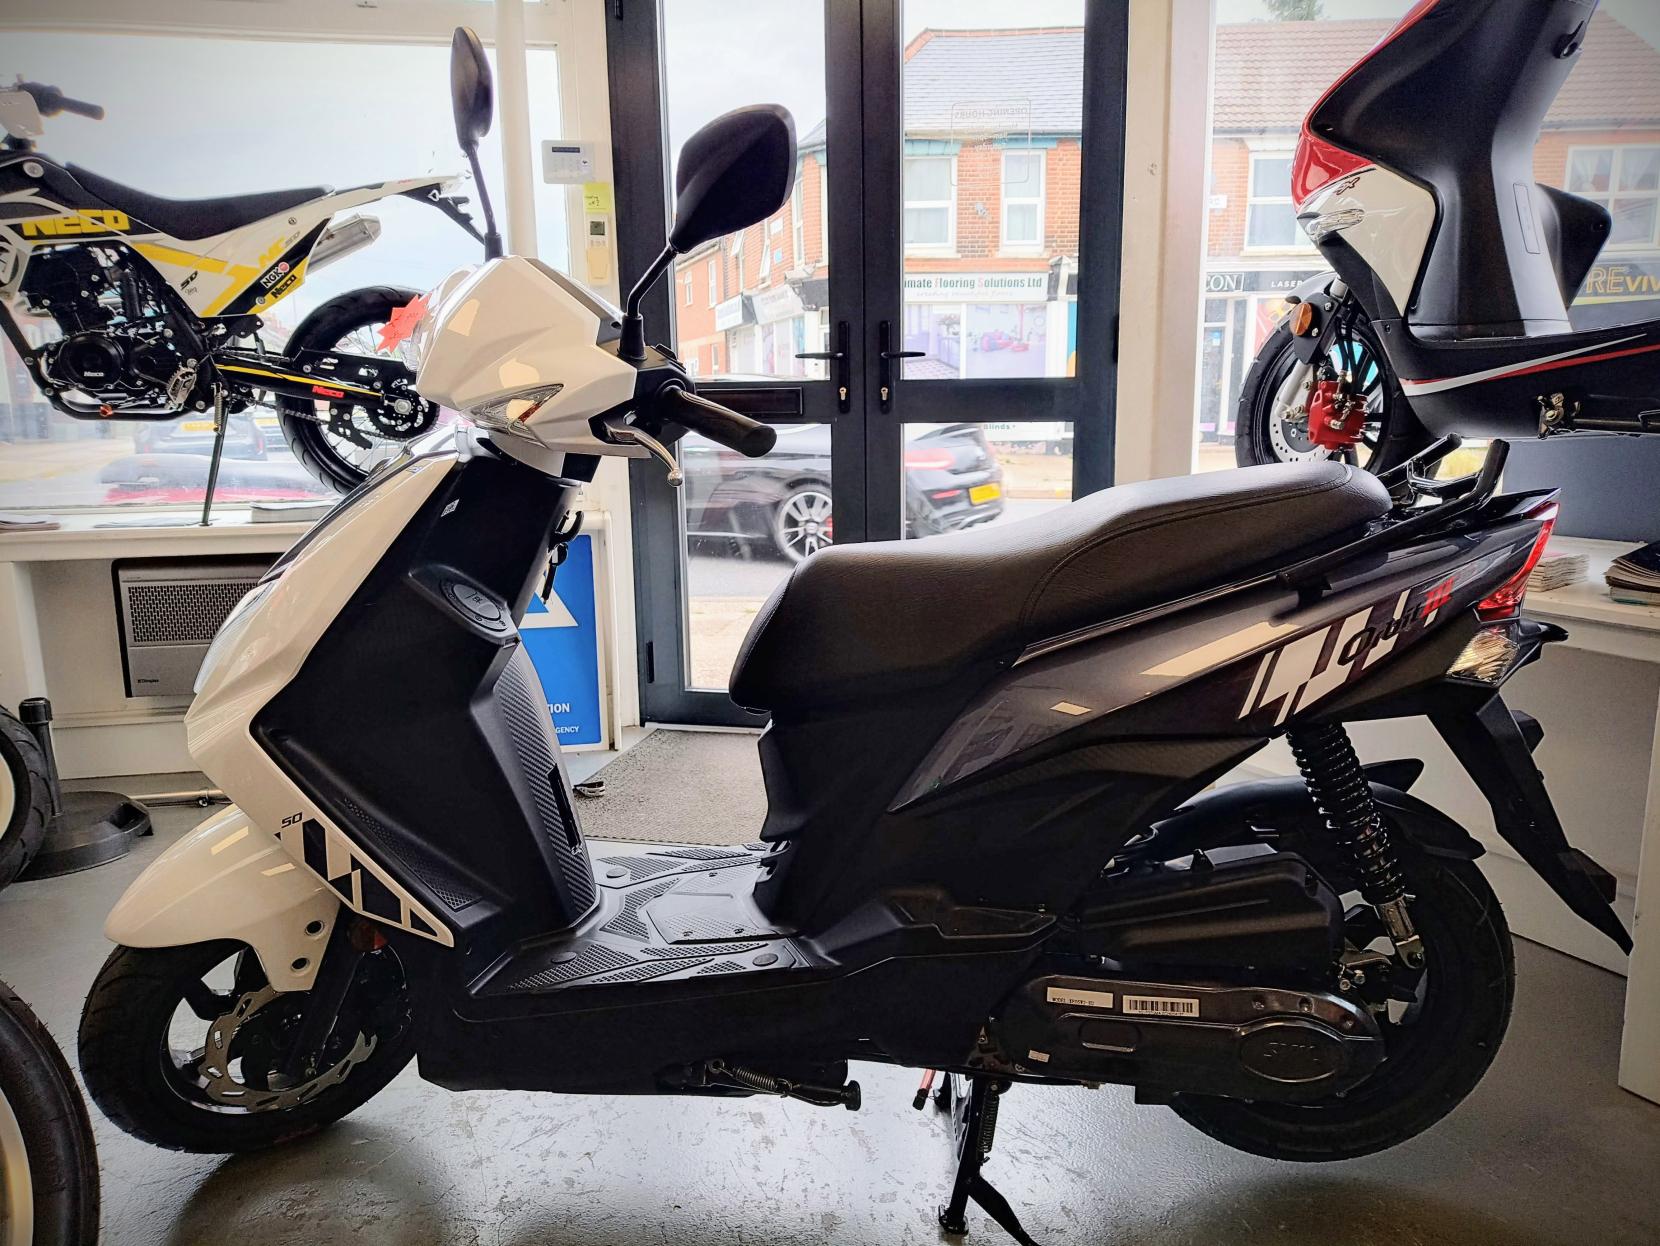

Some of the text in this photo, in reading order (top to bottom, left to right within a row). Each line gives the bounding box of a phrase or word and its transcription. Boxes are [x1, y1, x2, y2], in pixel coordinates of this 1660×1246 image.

[262, 265, 287, 288] NGK
[935, 277, 975, 289] Flooring
[977, 277, 1025, 288] Solutions
[1027, 277, 1042, 288] Ltd
[281, 811, 303, 829] 50
